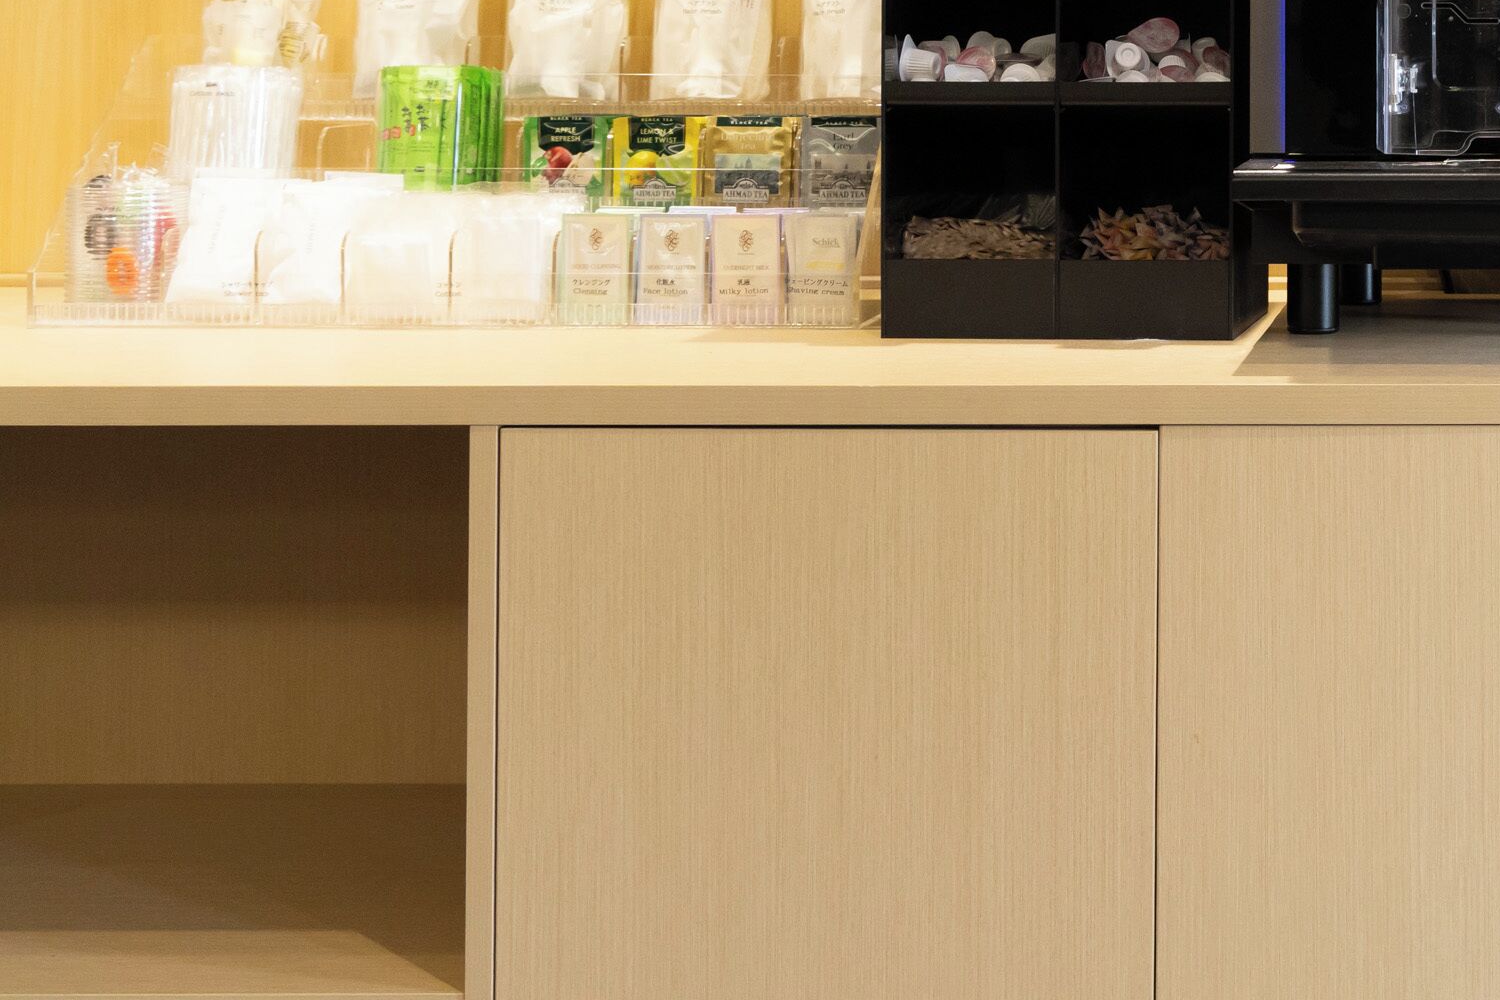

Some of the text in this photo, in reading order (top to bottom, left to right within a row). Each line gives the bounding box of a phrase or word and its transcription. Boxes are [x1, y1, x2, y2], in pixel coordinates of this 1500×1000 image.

[639, 127, 667, 135] LEMON
[550, 135, 581, 143] REFRESH
[636, 136, 677, 144] LIME TWIST
[832, 143, 852, 152] Grey
[634, 190, 676, 199] AHMAD TEA
[724, 191, 769, 199] AHMAD TEA
[821, 191, 865, 199] AHMAD TEA
[571, 278, 611, 287] クレンジング
[655, 278, 676, 286] 化粧水
[643, 287, 689, 296] Face lotion
[719, 287, 769, 296] Milky lotion
